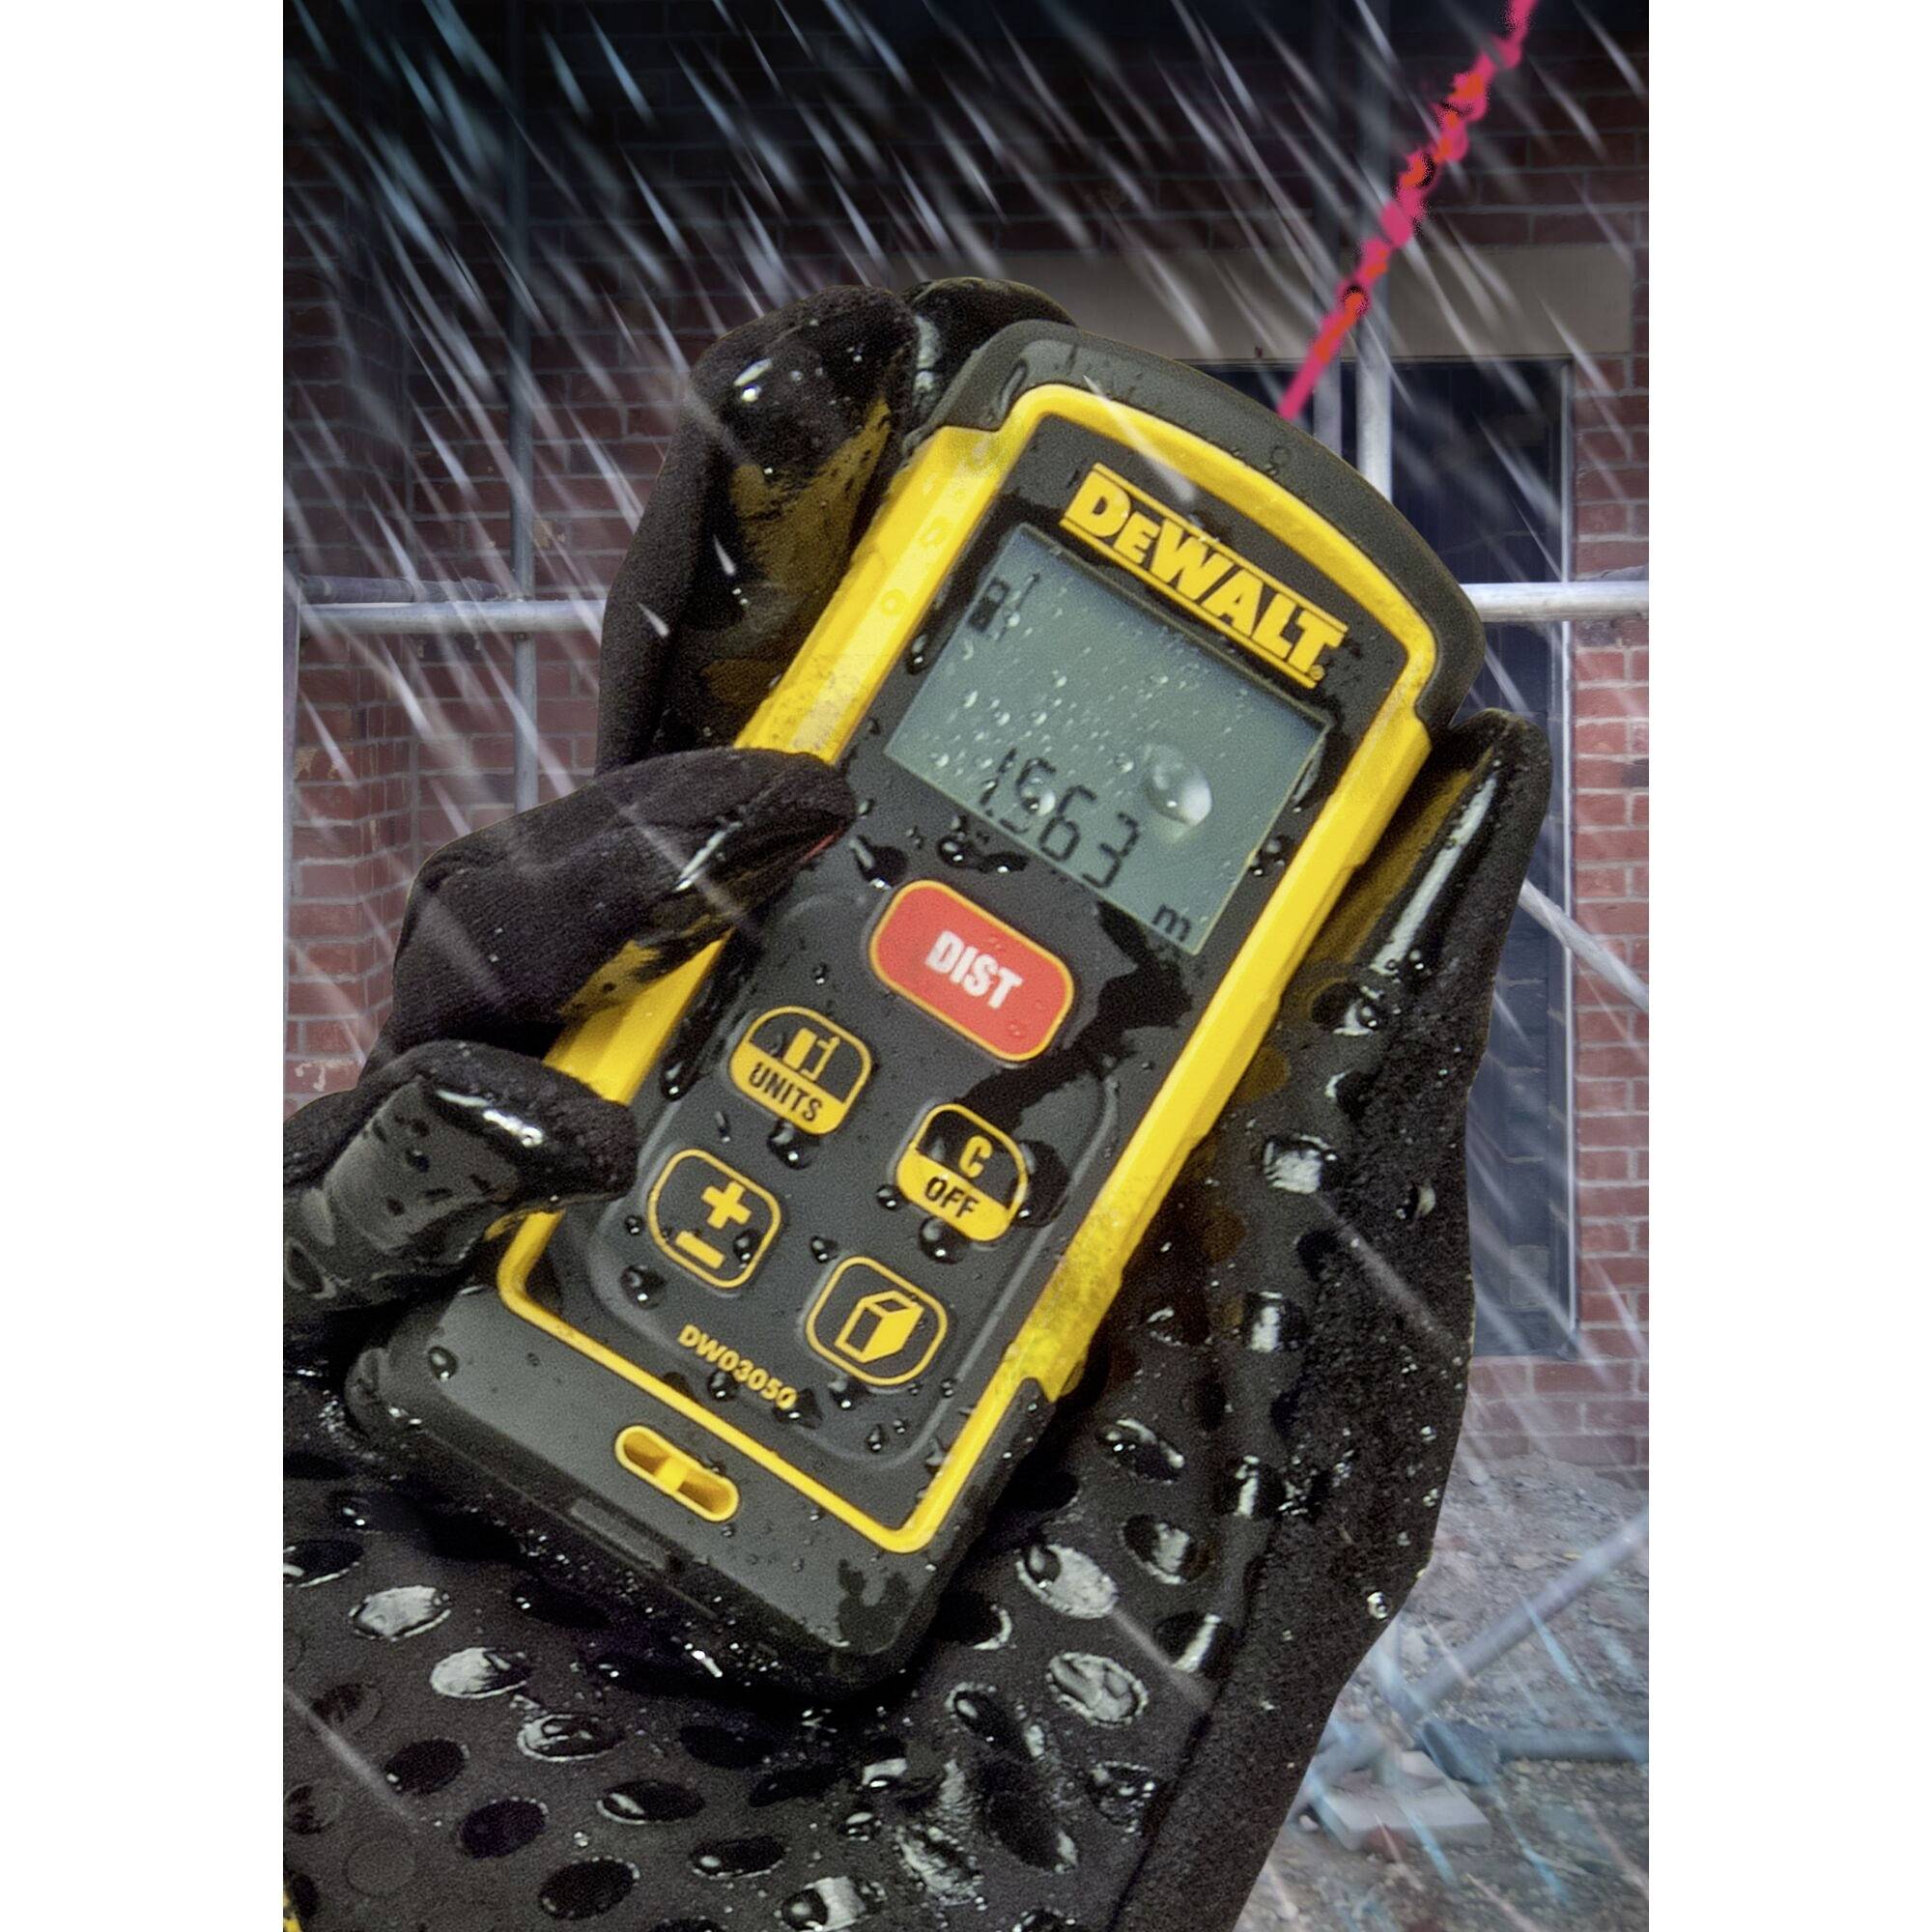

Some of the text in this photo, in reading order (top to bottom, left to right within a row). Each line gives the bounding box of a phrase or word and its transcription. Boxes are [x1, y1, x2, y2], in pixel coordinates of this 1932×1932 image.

[1151, 903, 1191, 943] m
[925, 931, 1022, 1009] DIST
[749, 1063, 823, 1122] UNITS
[959, 1135, 993, 1179] C
[924, 1177, 980, 1218] OFF
[678, 1323, 799, 1412] DW03050
